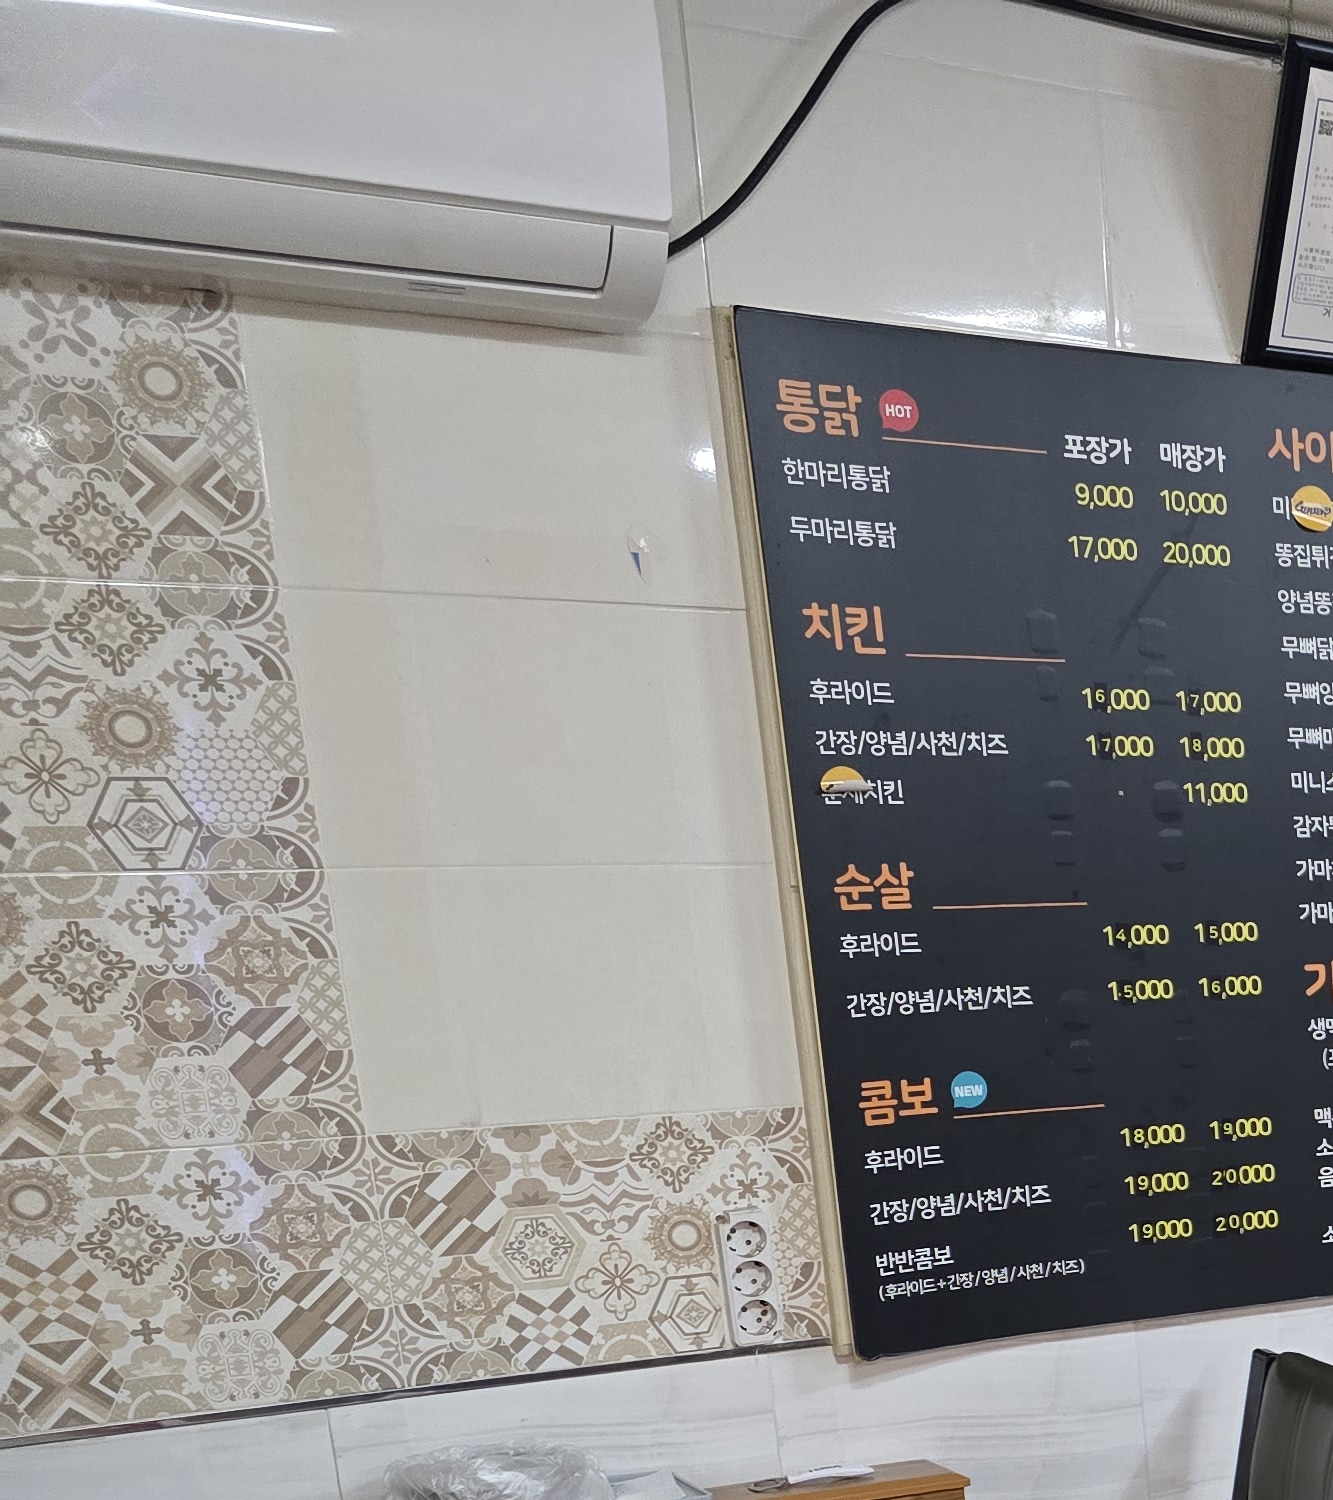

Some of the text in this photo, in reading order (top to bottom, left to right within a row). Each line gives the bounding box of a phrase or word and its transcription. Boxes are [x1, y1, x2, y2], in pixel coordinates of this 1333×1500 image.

[775, 378, 912, 438] 통닭 HOT
[1063, 434, 1227, 473] 포장가 매장가
[781, 456, 1228, 517] 한마리통닭 9,000 10,000
[789, 515, 1231, 569] 두마리통닭 17,000 20,000
[801, 601, 887, 655] 치킨
[809, 677, 1242, 716] 후라이드 16,000 17,000
[815, 729, 1245, 762] 간장/양념/사천/치즈 17,000 18,000
[1182, 782, 1249, 807] 11,000
[833, 861, 915, 911] 순살
[839, 921, 1259, 959] 후라이드 14,000 15,000
[846, 975, 1263, 1018] 간장/양념/사천/치즈 15,000 16,000
[858, 1077, 983, 1127] 콤보 NEW
[864, 1116, 1273, 1174] 후라이드 18,000 19,000
[869, 1184, 1052, 1226] 간장/양념/사천/치즈
[1124, 1171, 1189, 1197] 19,000
[875, 1209, 1279, 1277] 반반콤보 19,000 20,000
